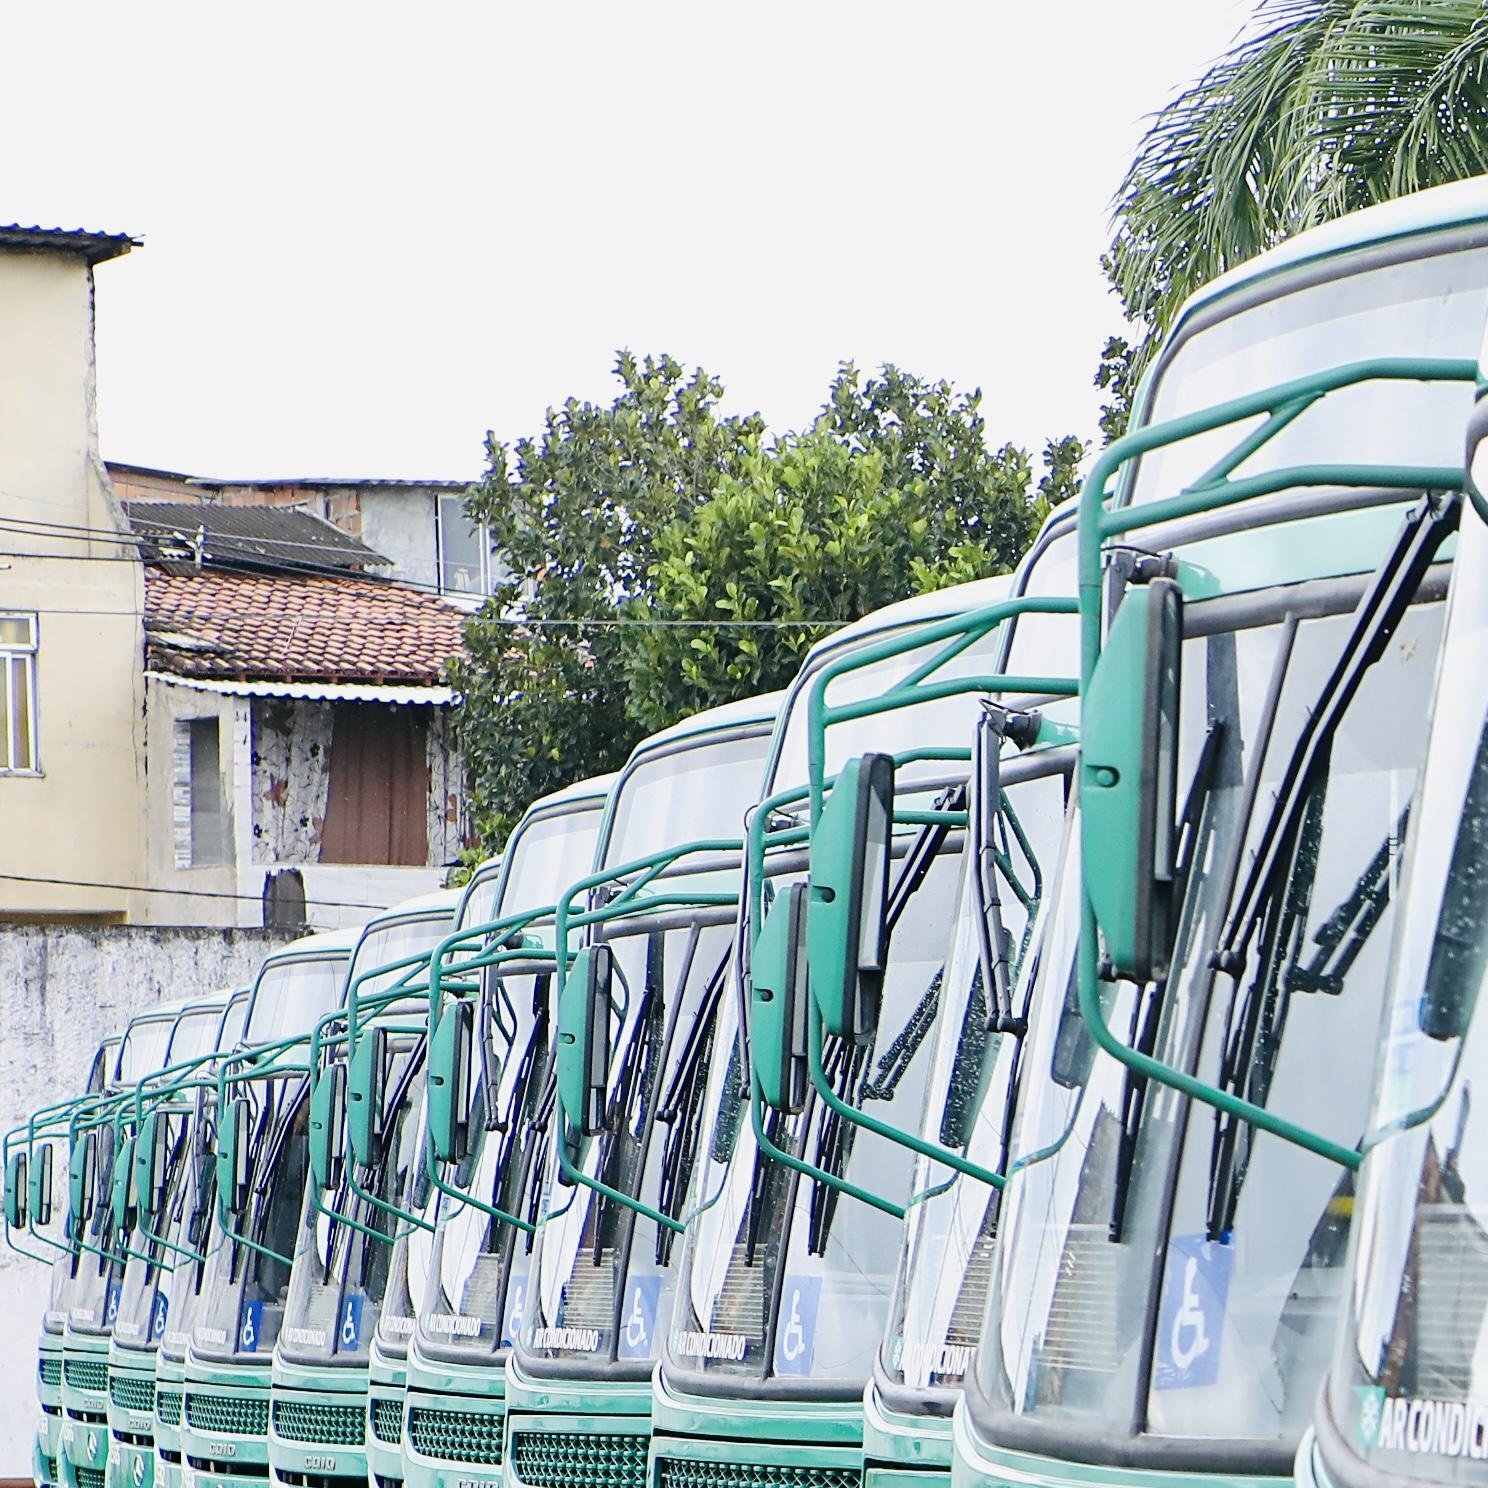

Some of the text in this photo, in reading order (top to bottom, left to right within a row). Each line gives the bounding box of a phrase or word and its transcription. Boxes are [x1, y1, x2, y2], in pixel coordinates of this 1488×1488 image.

[543, 1328, 599, 1352] CONDICIONADO
[686, 1331, 746, 1361] CONDICIONADO
[1378, 1398, 1408, 1451] AR
